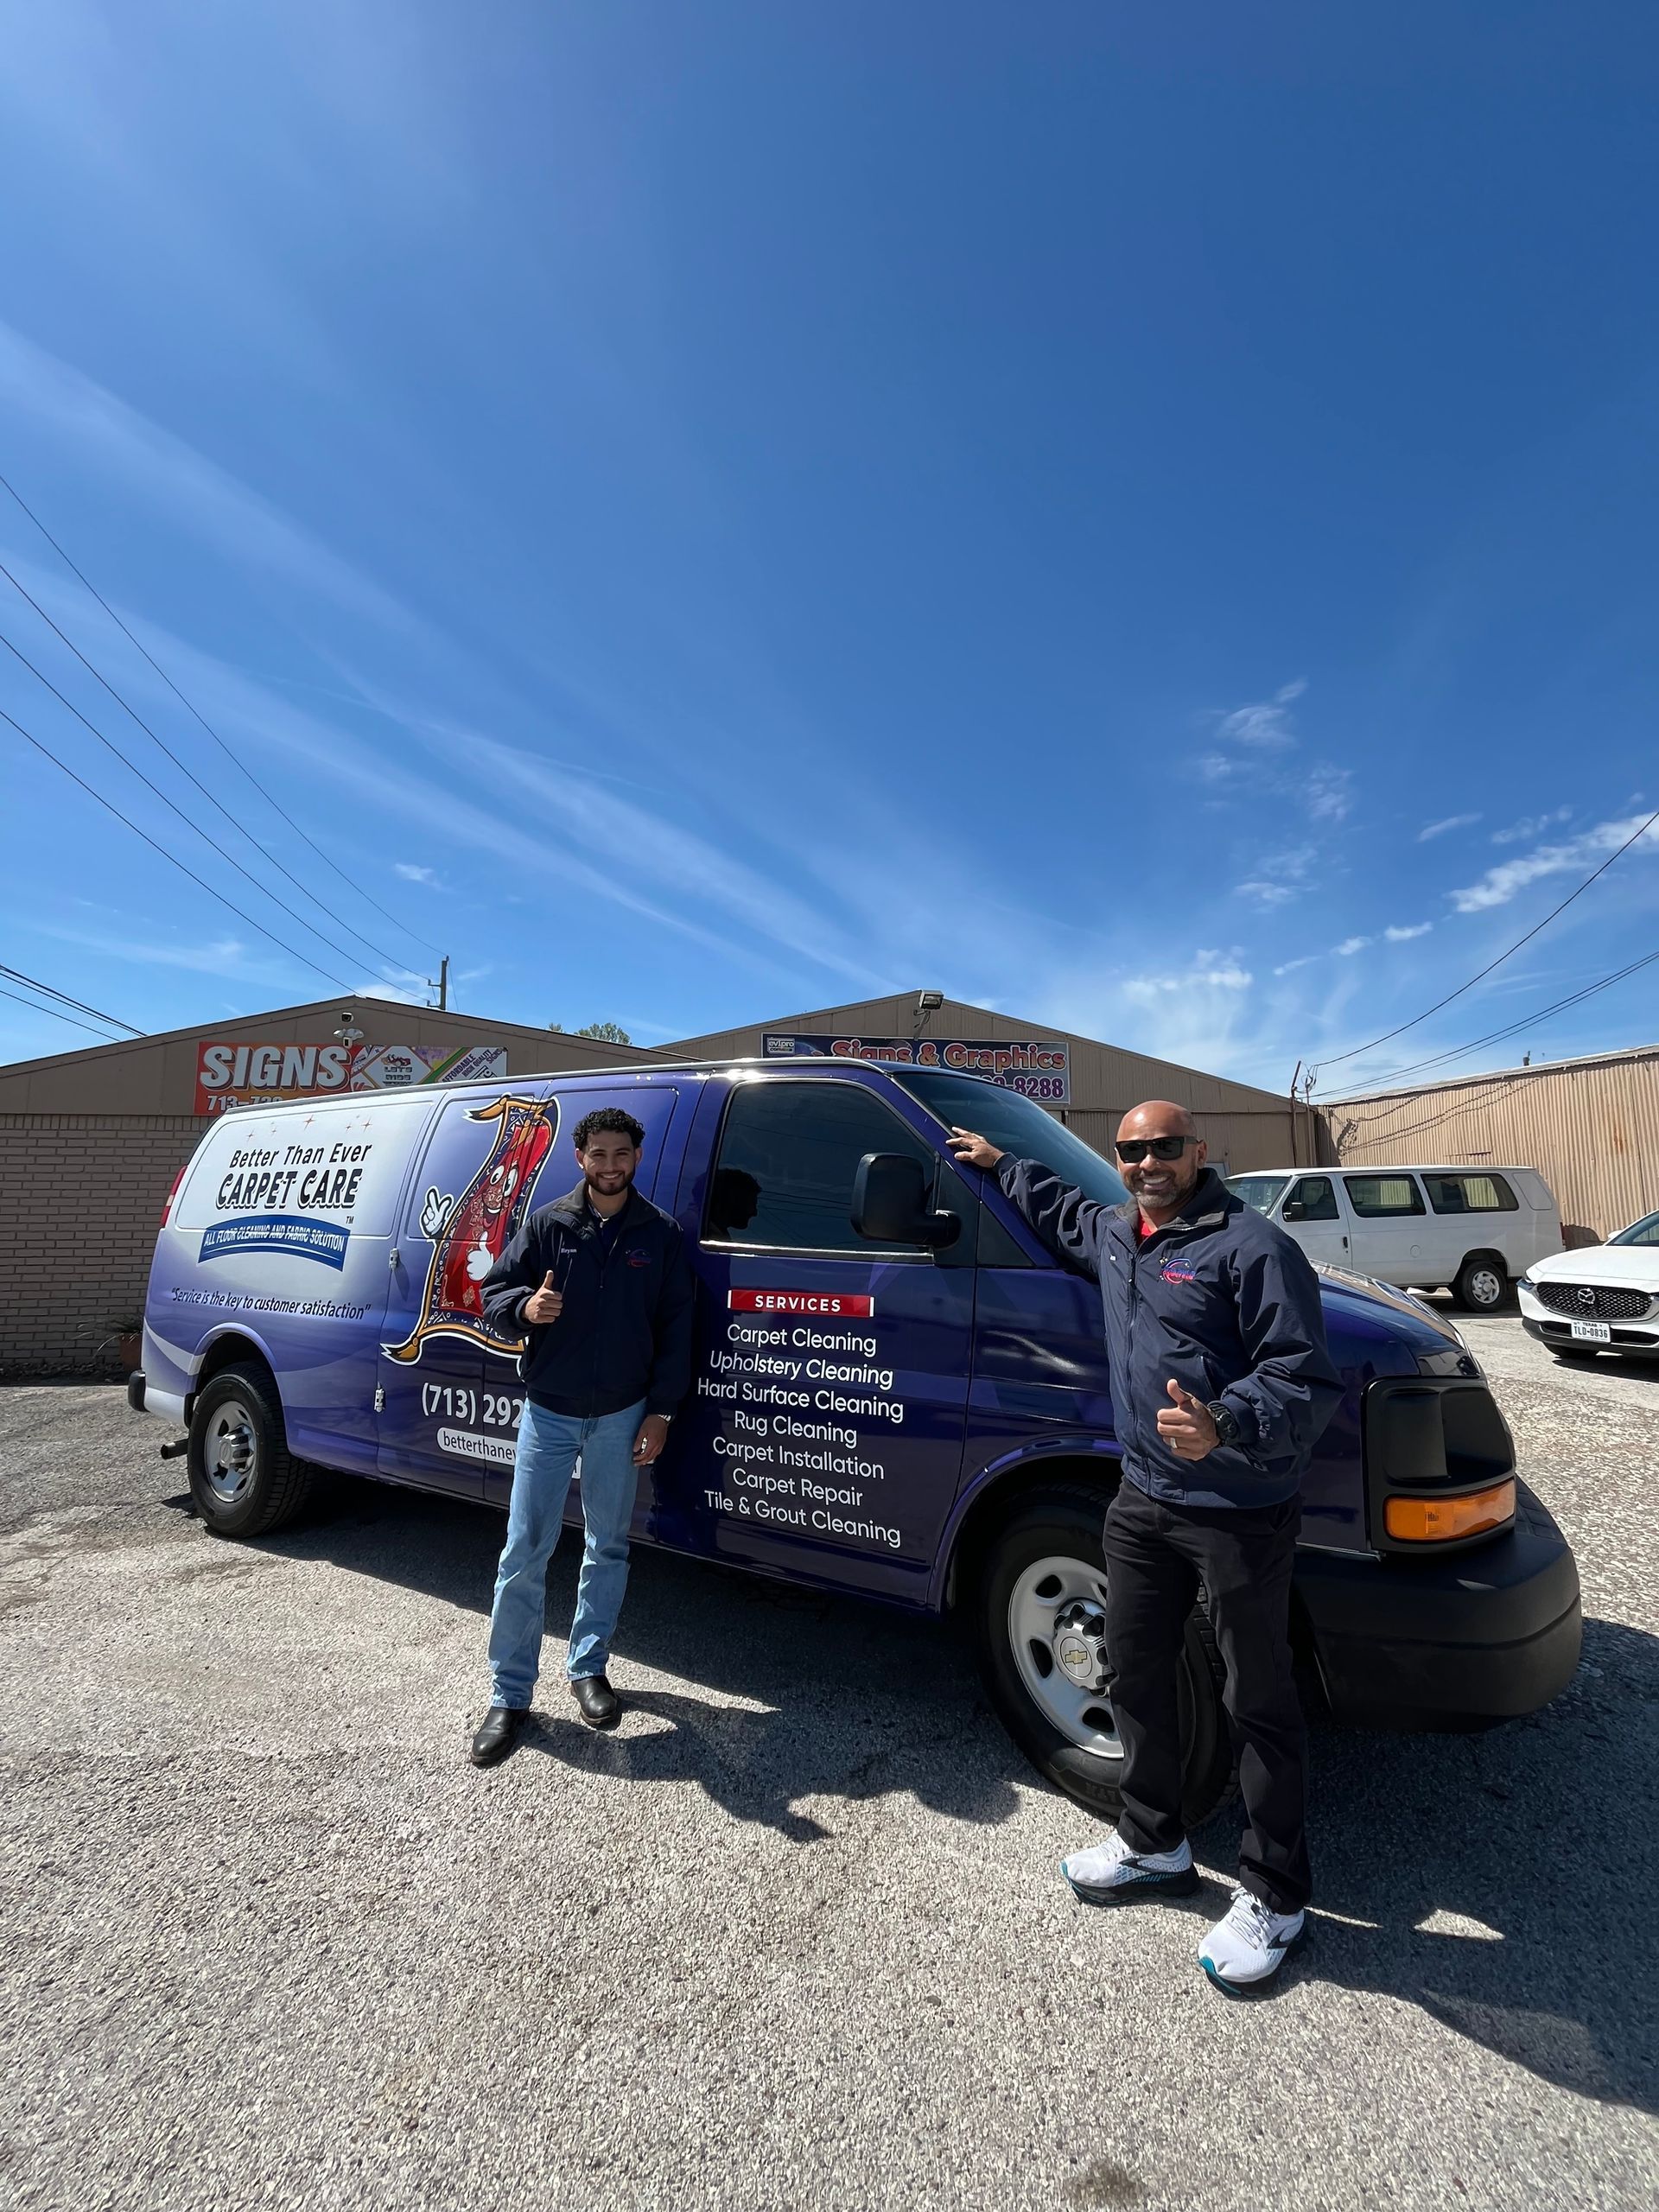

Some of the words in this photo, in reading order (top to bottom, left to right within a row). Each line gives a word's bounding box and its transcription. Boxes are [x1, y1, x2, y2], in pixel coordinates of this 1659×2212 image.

[200, 1046, 350, 1090] SIGNS
[442, 1053, 476, 1082] AFFORDABLE
[473, 1049, 492, 1067] QUALITY
[486, 1048, 503, 1064] SIGNS
[917, 1042, 940, 1067] &
[943, 1043, 1066, 1074] Graphics
[229, 1148, 279, 1168] Better
[283, 1145, 325, 1165] Than
[329, 1142, 372, 1163] Ever
[216, 1171, 299, 1210] CARPET
[297, 1168, 363, 1209] CARE
[204, 1232, 215, 1247] ALL
[309, 1228, 345, 1252] SOLUTION
[200, 1290, 211, 1305] is
[210, 1291, 225, 1306] the
[225, 1292, 243, 1312] key
[243, 1295, 253, 1309] to
[254, 1297, 301, 1314] customer
[754, 1295, 841, 1313] SERVICES
[727, 1324, 788, 1348] Carpet
[791, 1327, 877, 1357] Cleaning
[709, 1350, 802, 1380] Upholstery
[805, 1359, 893, 1390] Cleaning
[422, 1382, 475, 1425] (713)
[697, 1377, 737, 1399] Hard
[741, 1382, 810, 1408] Surface
[815, 1389, 904, 1424] Cleaning
[734, 1410, 767, 1437] Rug
[772, 1415, 857, 1449] Cleaning
[713, 1436, 774, 1464] Carpet
[779, 1445, 885, 1480] Installation
[733, 1467, 796, 1496] Carpet
[801, 1478, 863, 1507] Repair
[704, 1490, 734, 1512] Tile
[738, 1497, 751, 1516] &
[755, 1500, 807, 1526] Grout
[811, 1510, 901, 1548] Cleaning
